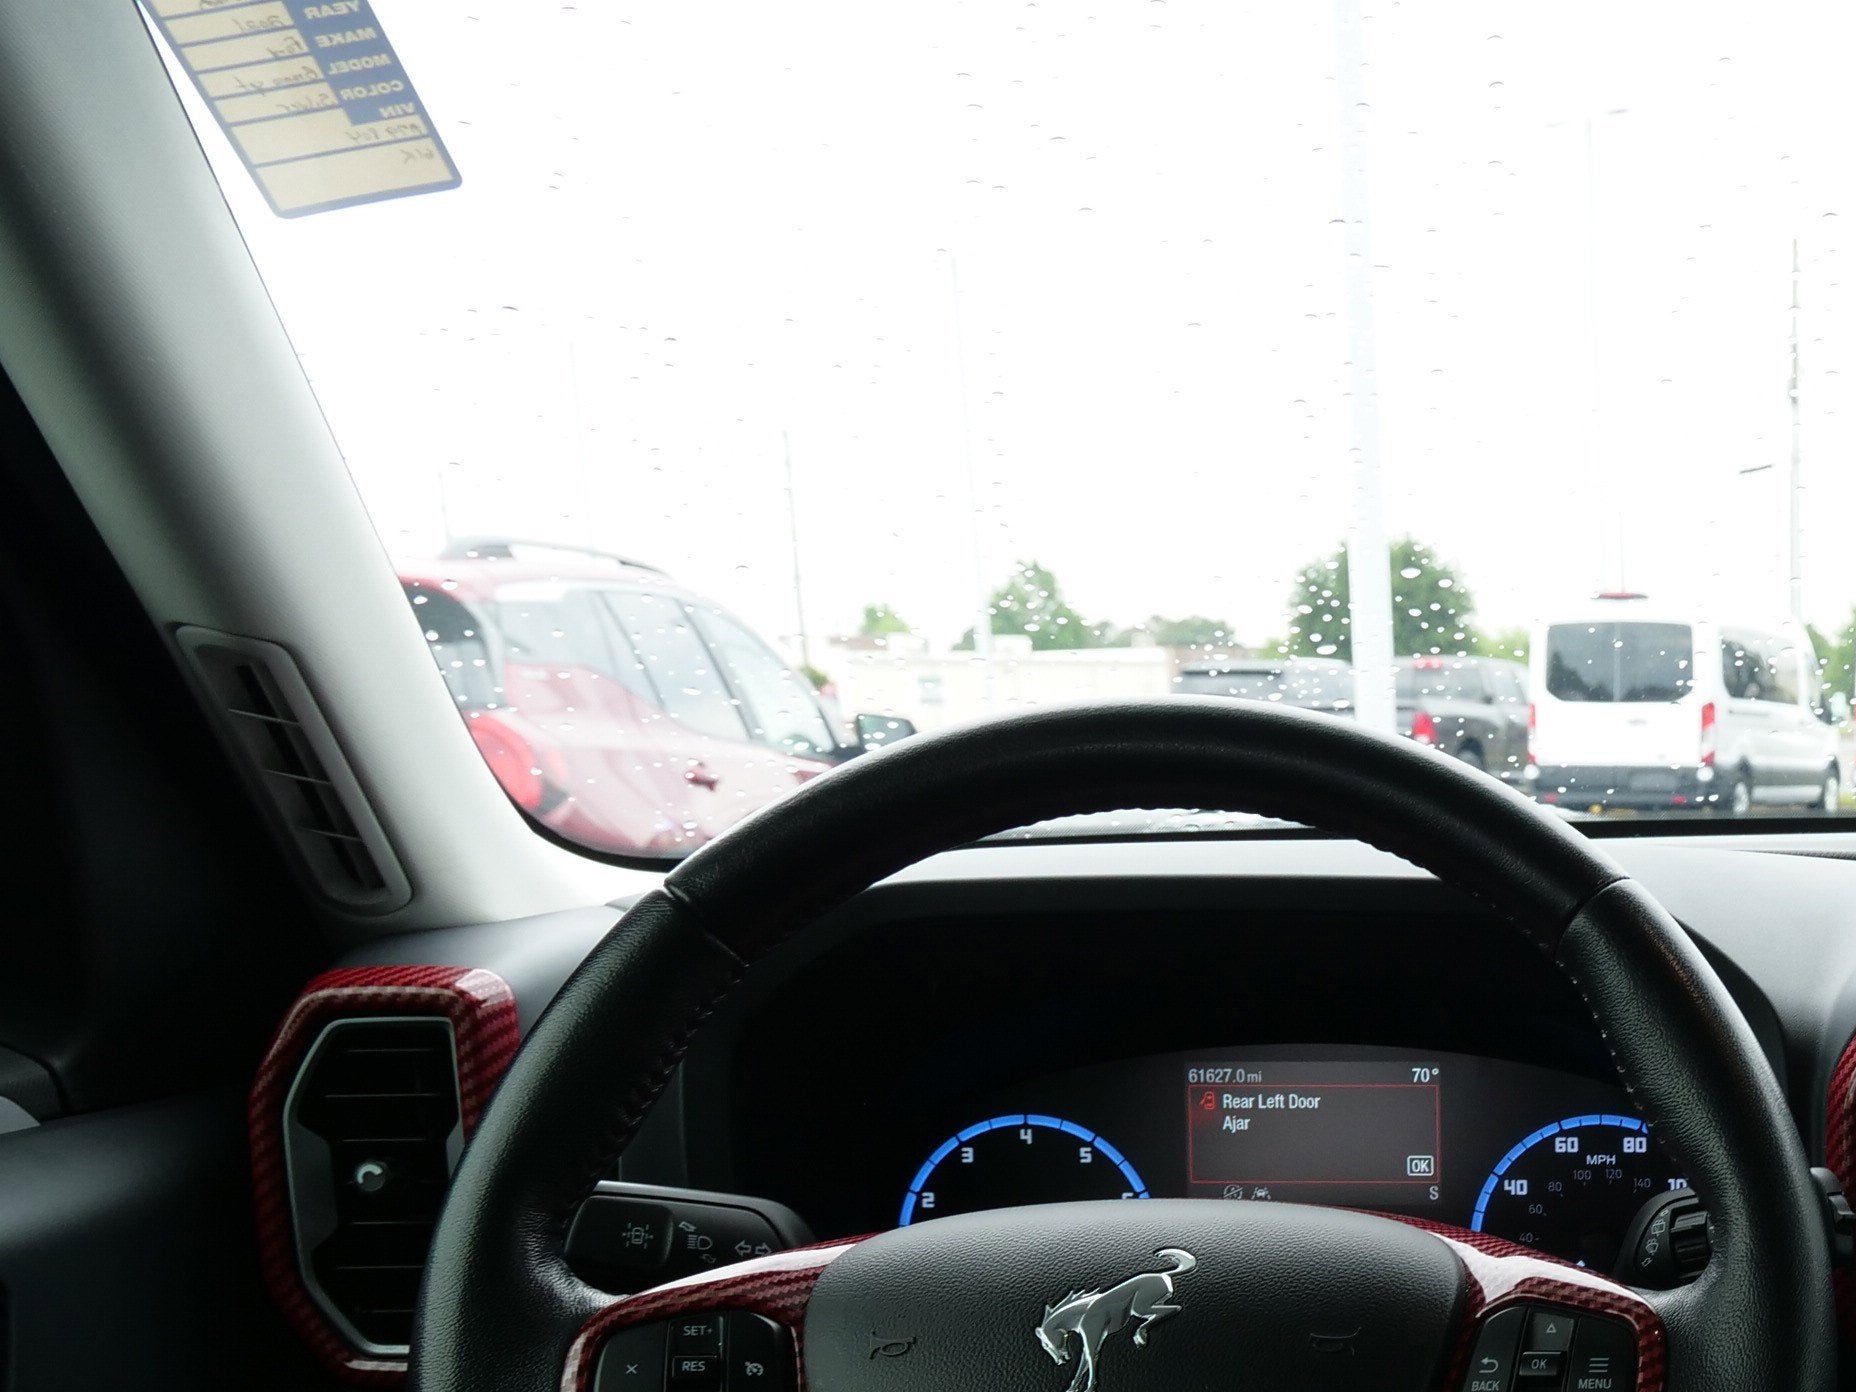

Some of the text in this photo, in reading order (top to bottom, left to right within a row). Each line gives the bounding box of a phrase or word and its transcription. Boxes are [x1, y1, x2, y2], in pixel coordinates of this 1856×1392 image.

[1223, 1094, 1321, 1109] Rear Left Door
[1223, 1116, 1250, 1133] Ajar
[1019, 1128, 1033, 1145] 4
[1555, 1137, 1579, 1153] 60
[1623, 1137, 1647, 1153] 80
[961, 1147, 974, 1163] 3
[1079, 1147, 1092, 1163] 5
[1586, 1154, 1616, 1165] MPH
[1412, 1159, 1429, 1173] OK
[1573, 1170, 1592, 1181] 100
[1605, 1168, 1623, 1179] 120
[1504, 1179, 1528, 1195] 40
[1548, 1182, 1562, 1192] 80
[1634, 1178, 1651, 1189] 140
[1429, 1186, 1439, 1200] S
[921, 1192, 935, 1208] 2
[1528, 1204, 1543, 1215] 60
[1519, 1232, 1533, 1243] 40
[682, 1360, 706, 1371] RES
[1531, 1358, 1548, 1370] OK
[1471, 1380, 1500, 1392] BACK
[1577, 1378, 1612, 1390] MENU
